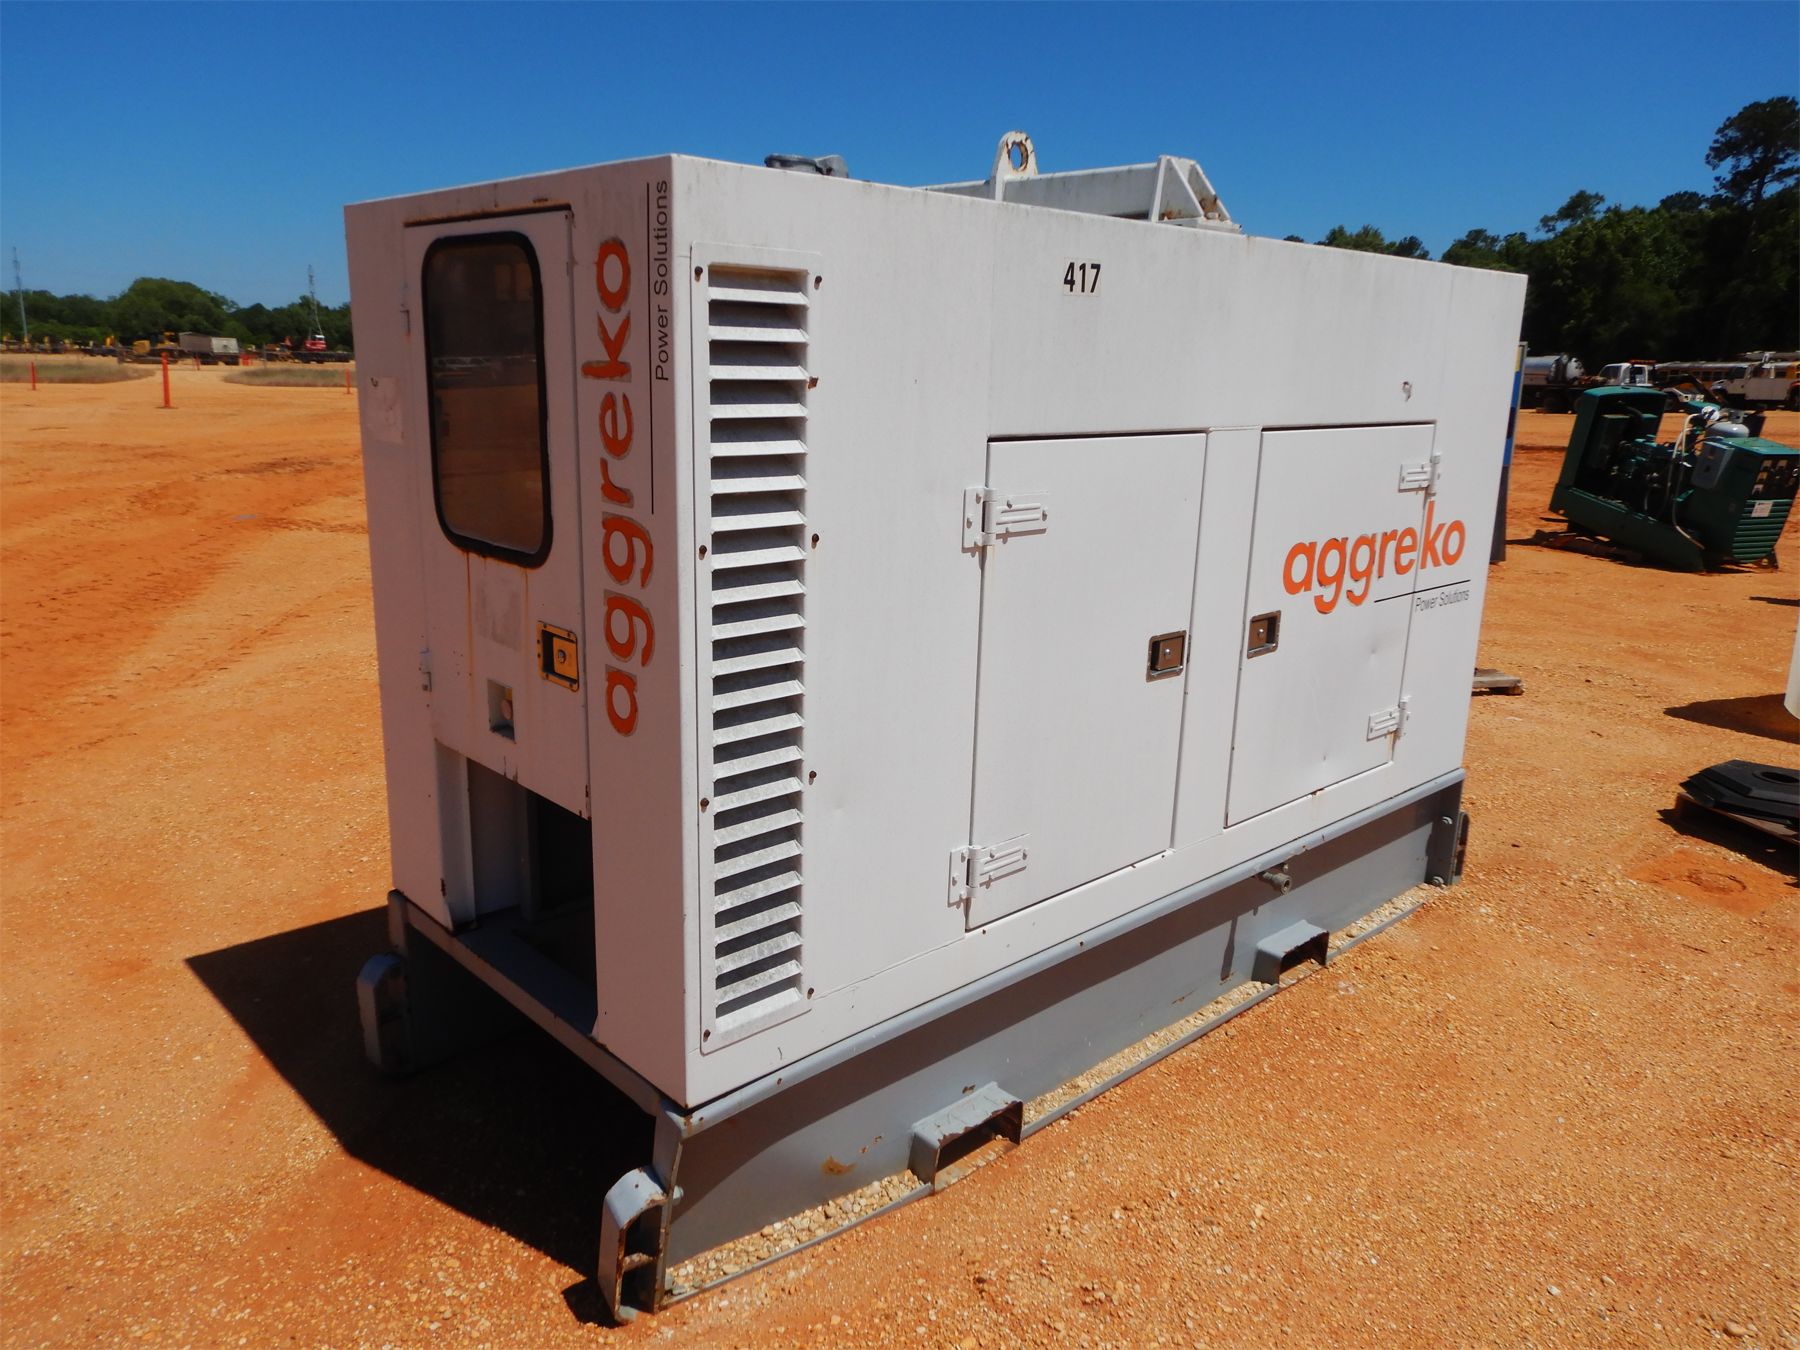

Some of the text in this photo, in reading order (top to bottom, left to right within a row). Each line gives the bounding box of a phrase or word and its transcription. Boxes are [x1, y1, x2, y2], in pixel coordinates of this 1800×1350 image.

[653, 180, 669, 381] Power Solutions
[1063, 262, 1101, 293] 417
[581, 237, 655, 737] aggreko
[1282, 499, 1466, 615] aggreko
[1414, 589, 1470, 613] Power Solutions
